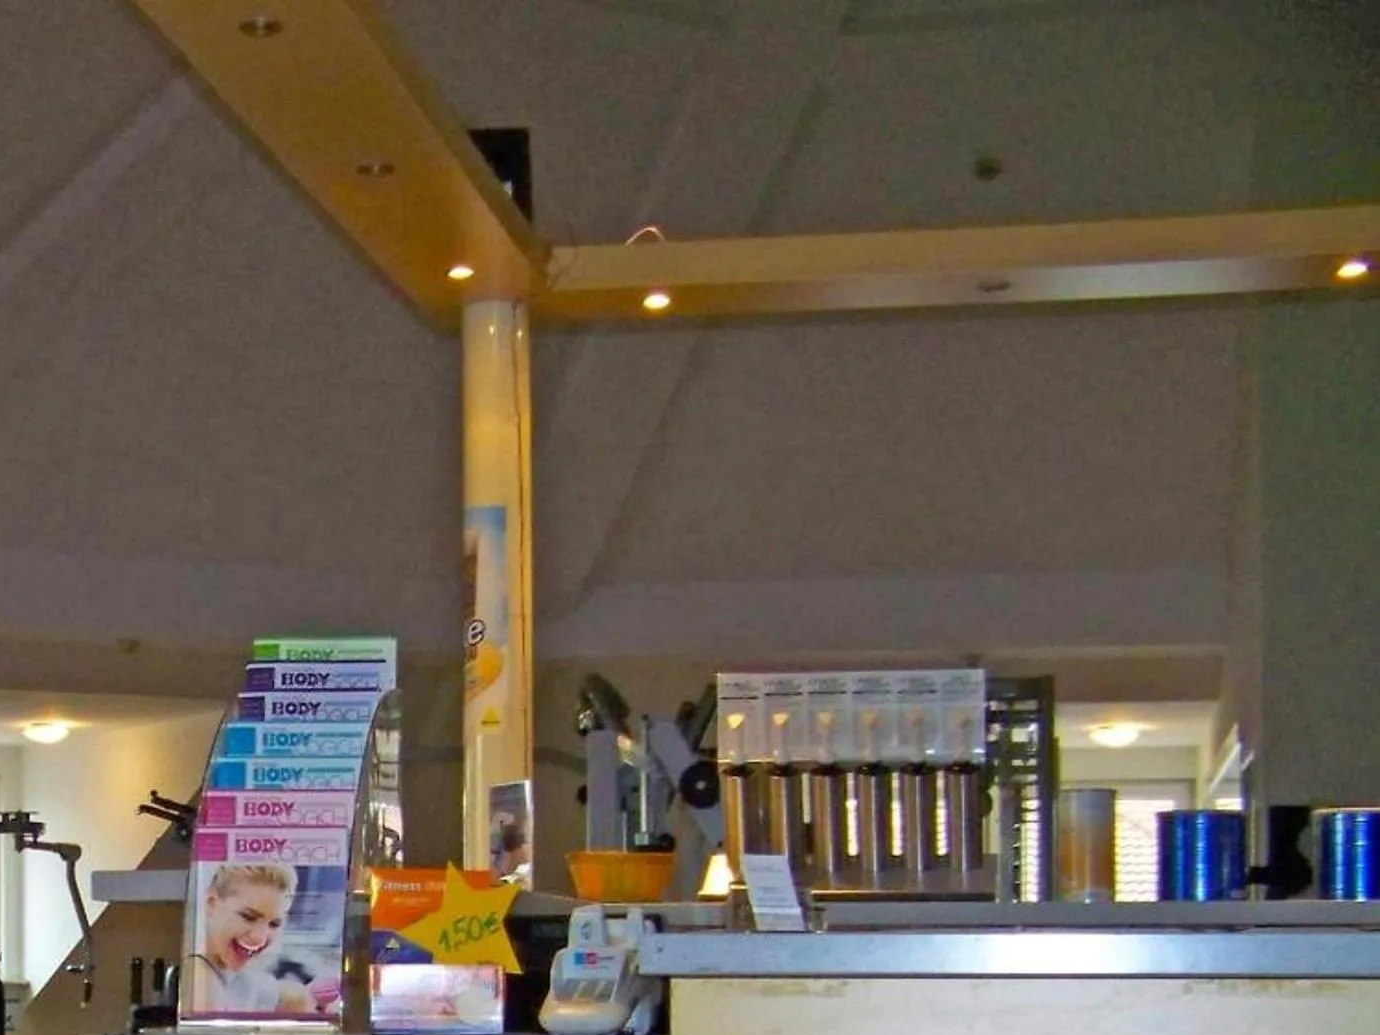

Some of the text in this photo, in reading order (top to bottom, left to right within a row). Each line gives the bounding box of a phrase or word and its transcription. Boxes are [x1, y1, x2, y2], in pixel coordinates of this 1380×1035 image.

[281, 672, 330, 686] BODY
[272, 702, 322, 716] BODY
[263, 731, 314, 747] BODY
[253, 767, 305, 782] BODY
[243, 801, 296, 817] BODY
[235, 838, 288, 854] BODY
